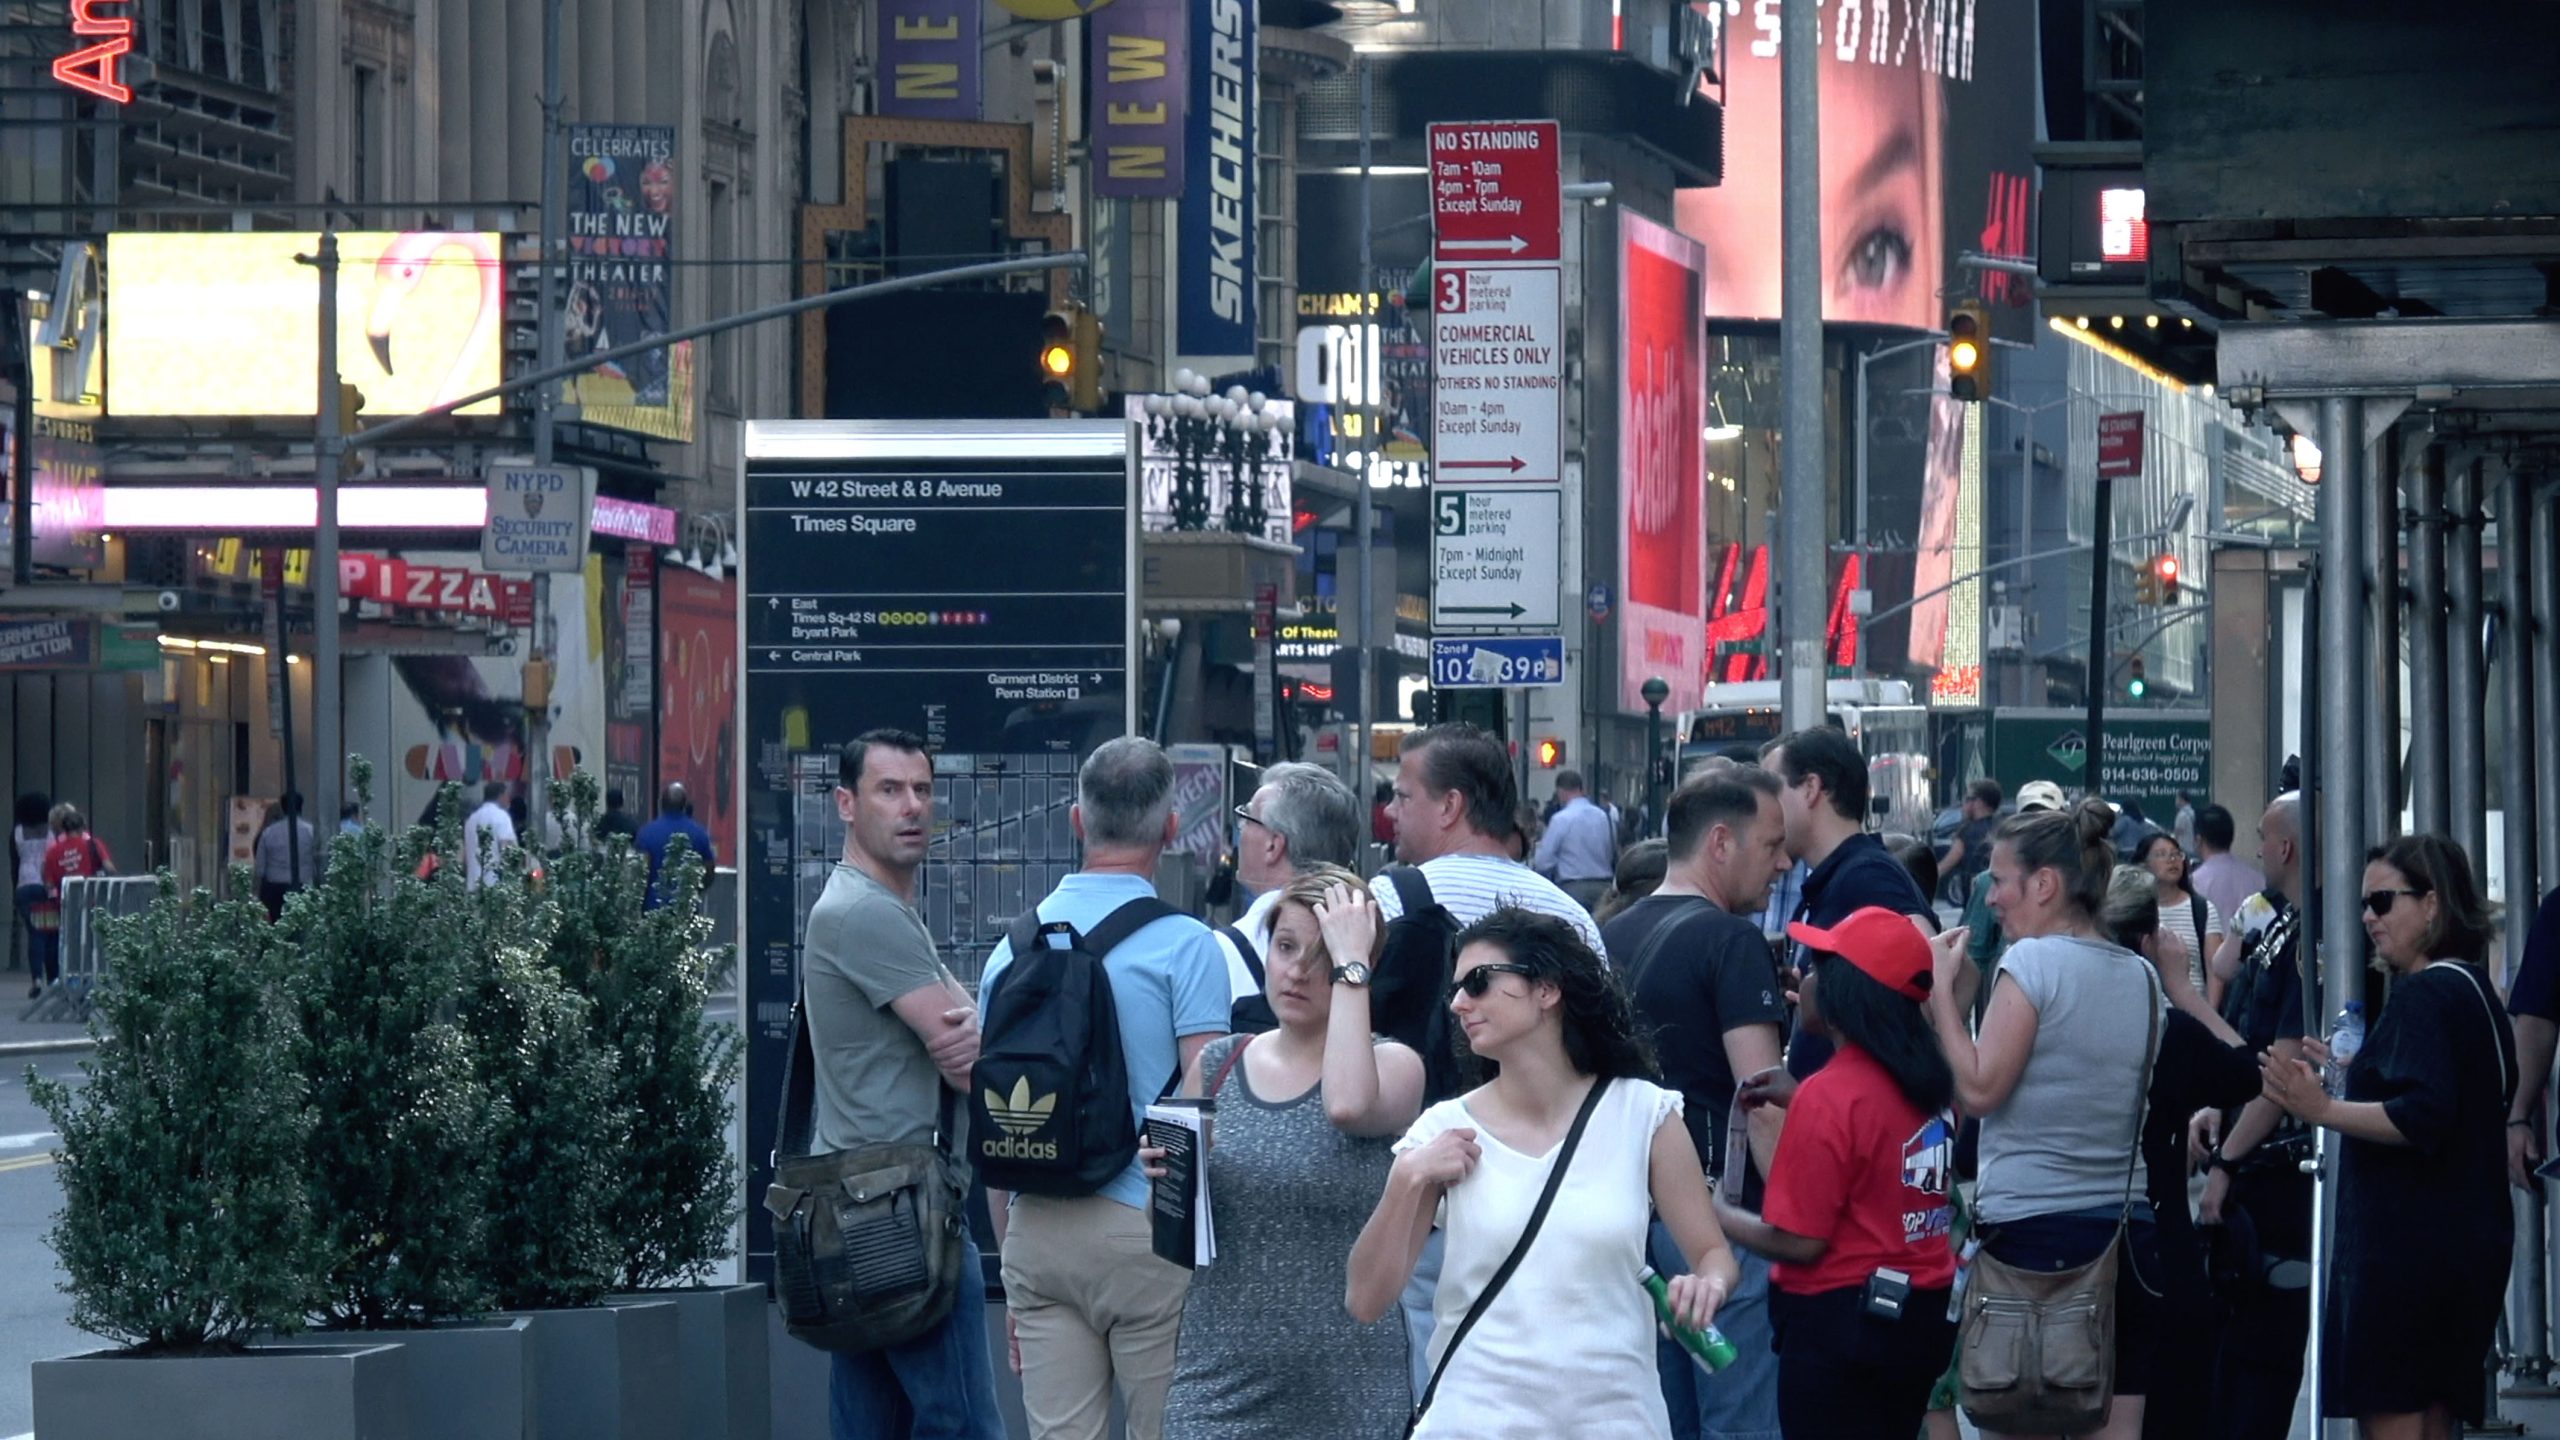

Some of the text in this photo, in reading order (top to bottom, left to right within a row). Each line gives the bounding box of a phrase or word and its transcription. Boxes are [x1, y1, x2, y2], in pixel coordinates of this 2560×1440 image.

[1107, 35, 1166, 178] NEW
[571, 138, 670, 159] CELEBRATES
[1435, 131, 1539, 150] NO STANDING
[1210, 0, 1243, 324] SKECHERS
[1436, 161, 1461, 176] 7am
[1471, 161, 1501, 176] 10am
[1437, 180, 1463, 197] 4pm
[1473, 179, 1499, 196] 7pm
[1438, 197, 1522, 215] Except Sunday
[571, 213, 668, 237] THE NEW
[1440, 273, 1491, 312] 3 hour
[1469, 286, 1511, 298] metered
[1469, 299, 1506, 313] parking
[1439, 325, 1535, 342] COMMERCIAL
[1440, 347, 1551, 365] VEHICLES ONLY
[1439, 376, 1557, 391] OTHERS NO STANDING
[1439, 402, 1468, 416] 10am
[1480, 402, 1505, 418] 4pm
[1439, 420, 1521, 437] Except Sunday
[505, 473, 563, 492] NYPD
[791, 481, 1003, 498] W 42 Street & 8 Avenue
[1439, 496, 1492, 535] 5 hour
[1469, 508, 1511, 521] metered
[492, 517, 573, 537] SECURITY
[791, 515, 916, 536] Times Square
[1469, 522, 1506, 536] parking
[495, 536, 568, 556] CAMERA
[1440, 548, 1464, 565] 7pm
[1475, 547, 1524, 566] Midnight
[1439, 565, 1522, 583] Except Sunday
[339, 558, 497, 611] PIZZA
[791, 599, 818, 610] East
[792, 613, 826, 624] Times
[828, 612, 861, 627] Sq-42
[863, 612, 876, 624] St
[791, 626, 858, 640] Bryant Park
[1282, 626, 1298, 639] Of
[791, 650, 861, 662] Central Park
[1437, 656, 1531, 682] 1039
[988, 673, 1079, 685] Garment District
[995, 687, 1066, 699] Penn Station
[2102, 732, 2166, 753] Pearlgreen
[982, 1136, 1058, 1160] adidas
